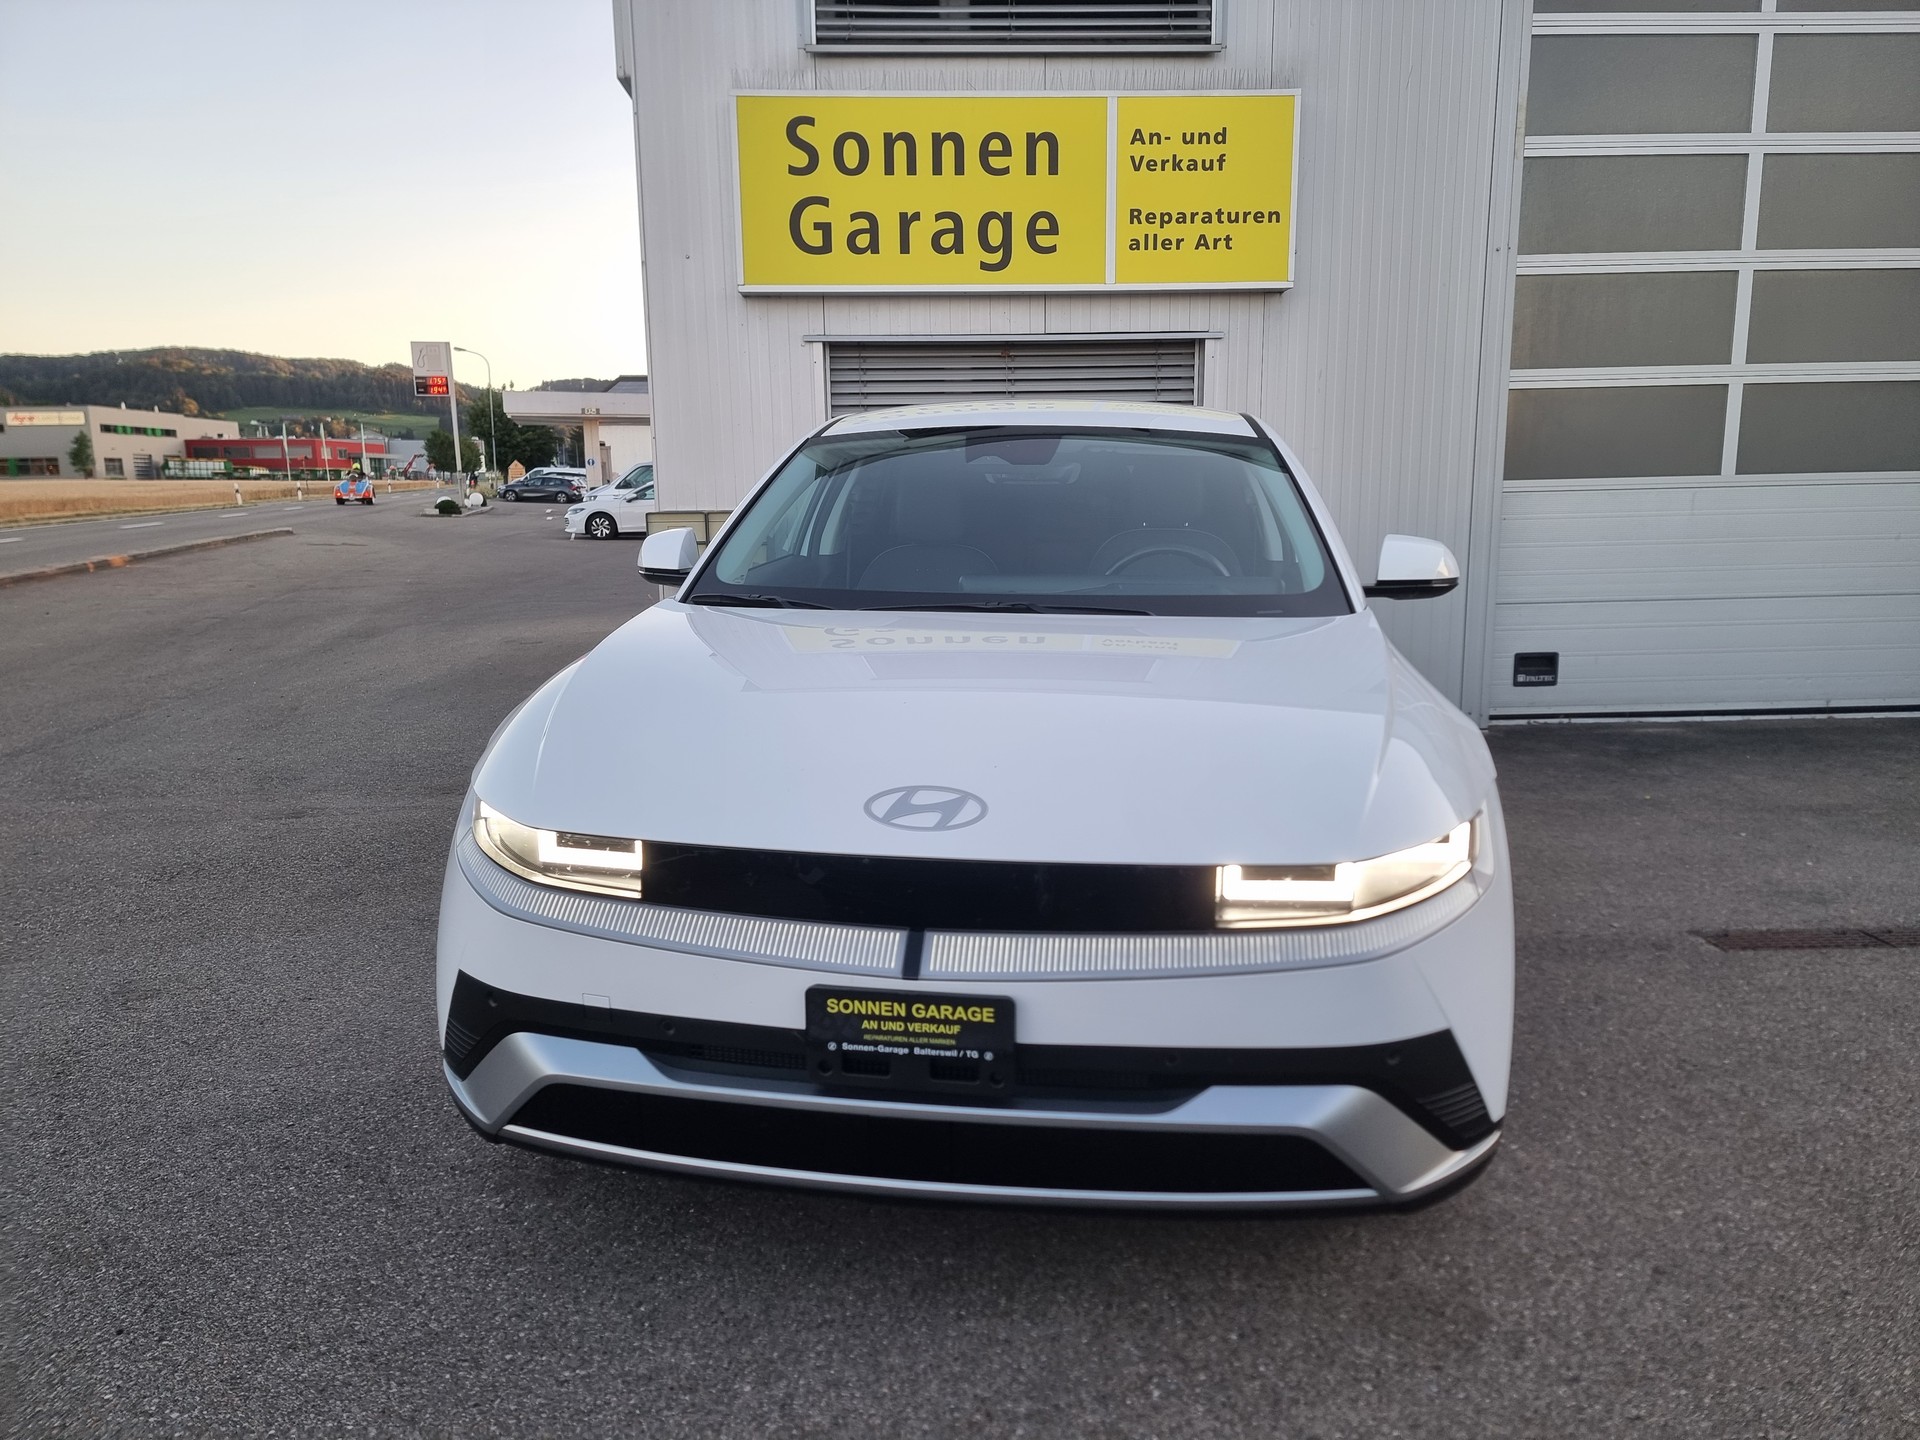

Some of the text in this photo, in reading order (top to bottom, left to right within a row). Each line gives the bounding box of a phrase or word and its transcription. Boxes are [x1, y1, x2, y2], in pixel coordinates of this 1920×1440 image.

[785, 115, 1059, 177] Sonnen
[1129, 126, 1227, 146] An- und
[1129, 153, 1227, 172] Verkauf
[1129, 207, 1281, 229] Reparaturen
[788, 195, 1060, 273] Garage
[1128, 233, 1233, 251] aller Art
[826, 998, 996, 1023] SONNEN GARAGE
[861, 1020, 962, 1035] AN UND VERKAUF
[841, 1042, 910, 1055] Sonnen-Garage
[913, 1047, 958, 1058] Balterswil
[965, 1050, 979, 1059] TG
